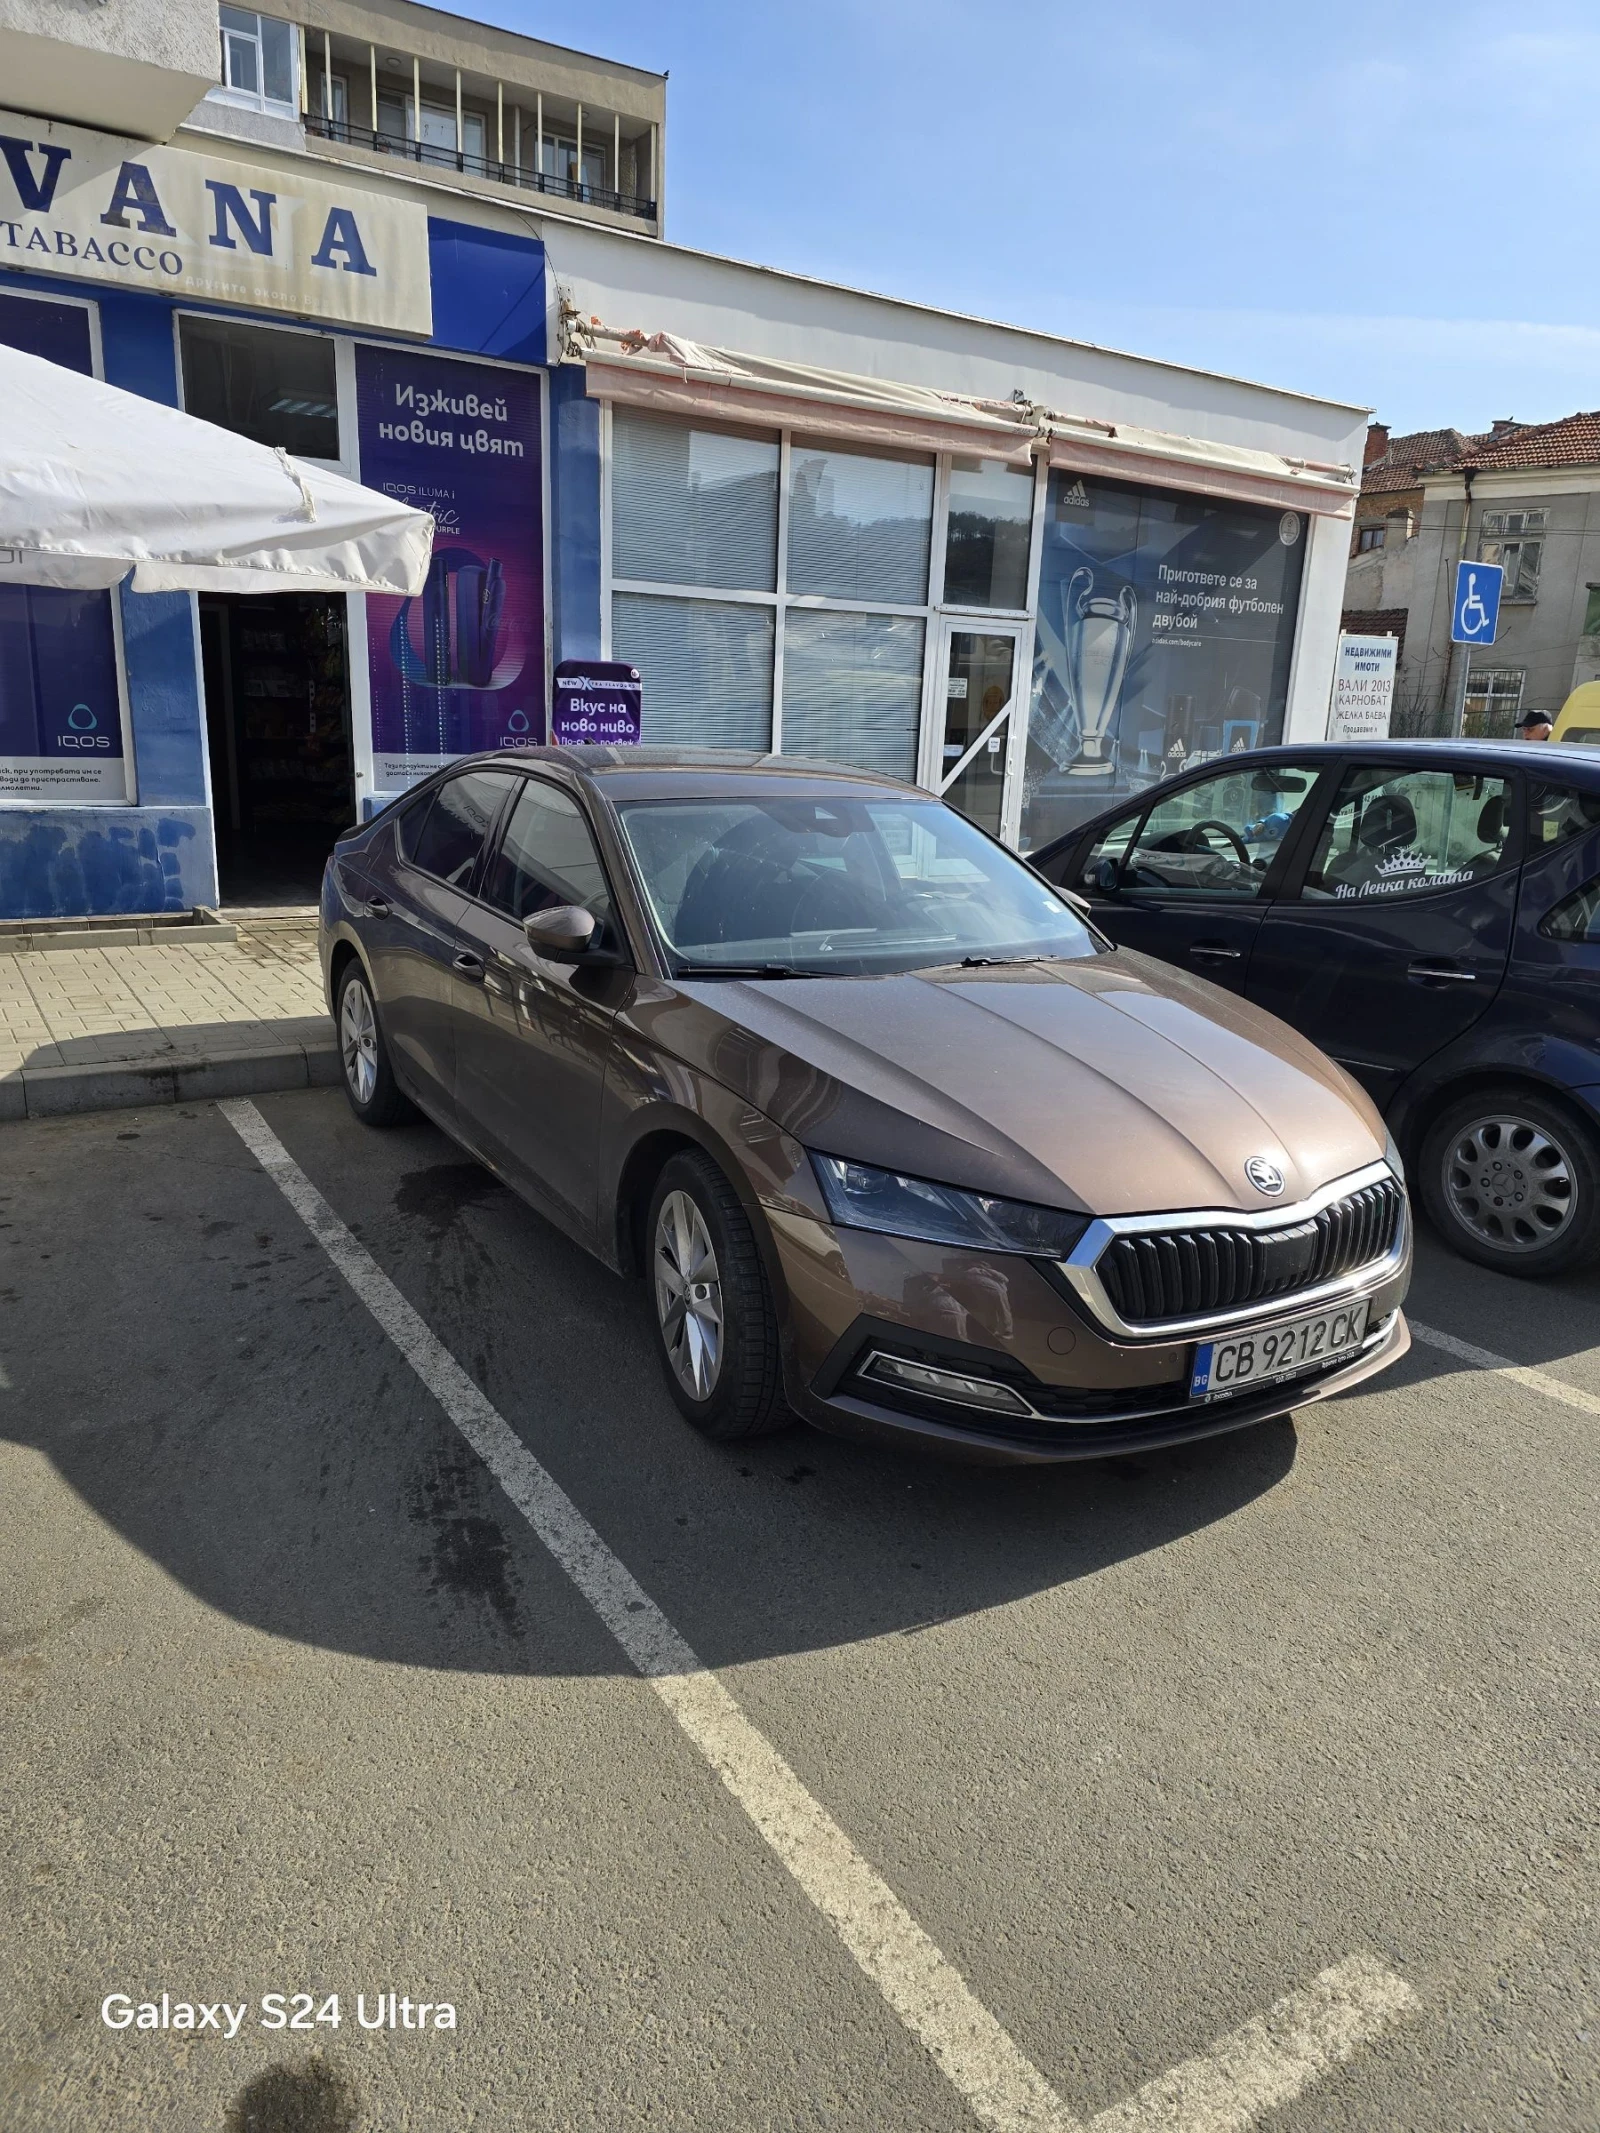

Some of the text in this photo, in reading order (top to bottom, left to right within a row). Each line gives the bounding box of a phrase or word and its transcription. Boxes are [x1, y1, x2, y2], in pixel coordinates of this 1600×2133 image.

[0, 135, 377, 277] VANA
[0, 220, 183, 275] TABACCO
[395, 383, 508, 422] Изживей
[379, 420, 524, 458] новия цвят
[383, 482, 416, 494] IQOS
[418, 487, 450, 498] ILUMA
[1063, 496, 1090, 507] adidas
[434, 525, 461, 535] URPLE
[1158, 564, 1258, 590] Пригответе се за
[1156, 589, 1284, 615] най-добрия футболен
[1152, 612, 1198, 630] двубой
[1345, 646, 1392, 658] НЕДВИЖИМИ
[1354, 662, 1380, 672] ИМОТИ
[1338, 678, 1391, 692] ВАЛИ 2013
[570, 698, 627, 716] Вкус на
[1338, 694, 1387, 706] КАРНОБАТ
[1336, 710, 1387, 720] ЖЕЛКА БАЕВА
[561, 718, 635, 734] ново ниво
[57, 735, 110, 749] IQOS
[499, 736, 538, 749] IQOS
[1335, 870, 1474, 899] На Ленка колата
[1215, 1340, 1255, 1383] CB
[1262, 1319, 1328, 1371] 9212
[1330, 1305, 1364, 1349] CK
[1193, 1374, 1209, 1388] BG
